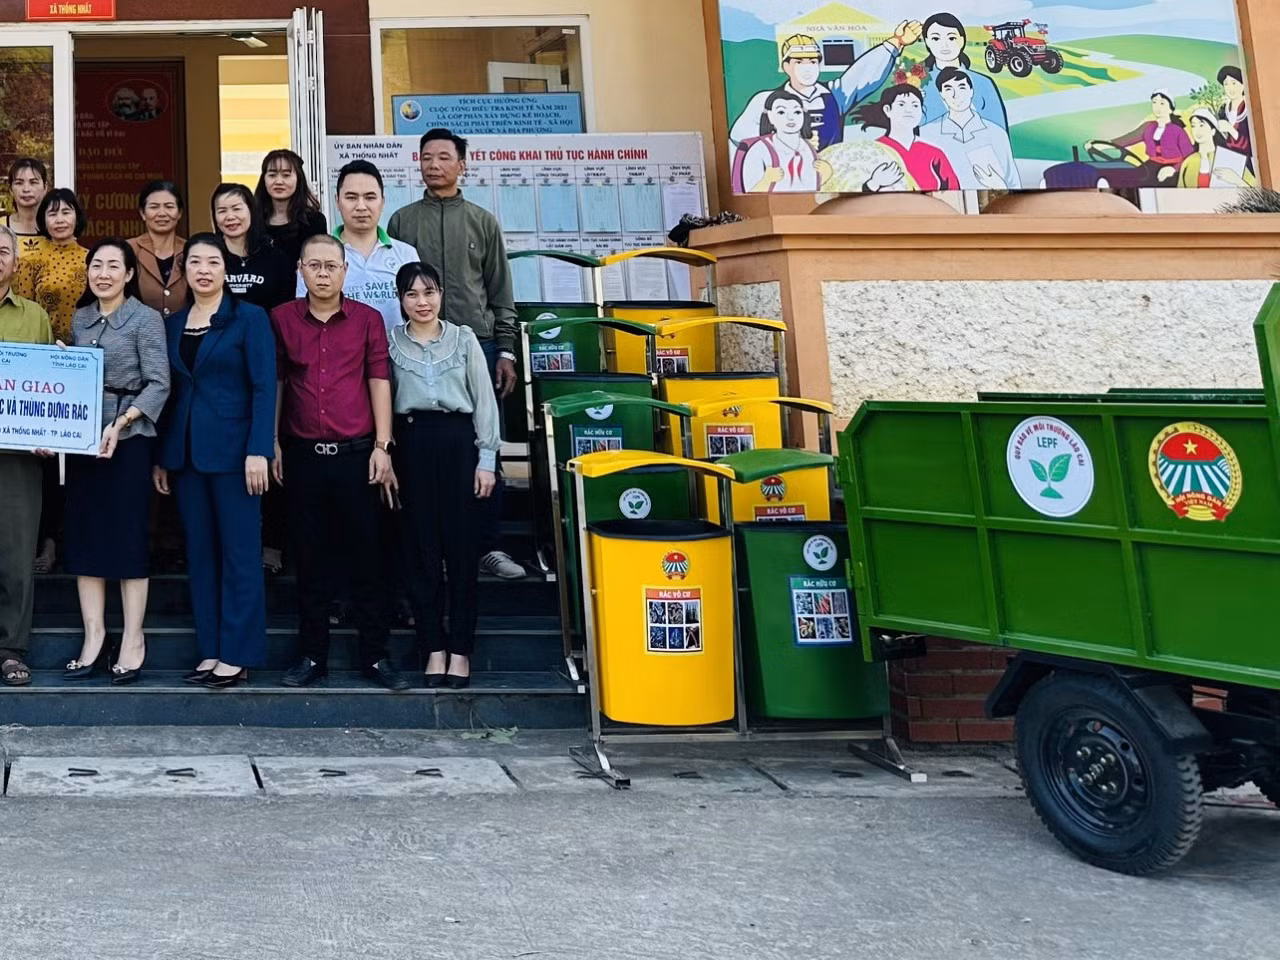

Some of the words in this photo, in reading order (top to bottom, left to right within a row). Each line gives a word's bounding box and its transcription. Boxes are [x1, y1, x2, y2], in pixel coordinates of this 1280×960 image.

[470, 150, 486, 160] YẾT
[488, 150, 516, 160] CÔNG
[520, 151, 542, 160] KHAI
[545, 146, 563, 160] THỦ
[566, 150, 584, 162] TỤC
[588, 148, 614, 160] HÀNH
[618, 148, 648, 159] CHÍNH
[224, 274, 264, 284] ARVARD
[365, 282, 389, 290] SAVE
[22, 380, 65, 394] GIAO
[6, 396, 17, 416] VÀ
[20, 398, 45, 418] THÙNG
[48, 401, 70, 421] ĐỰNG
[72, 401, 88, 420] RÁC
[1037, 437, 1058, 448] LEPF
